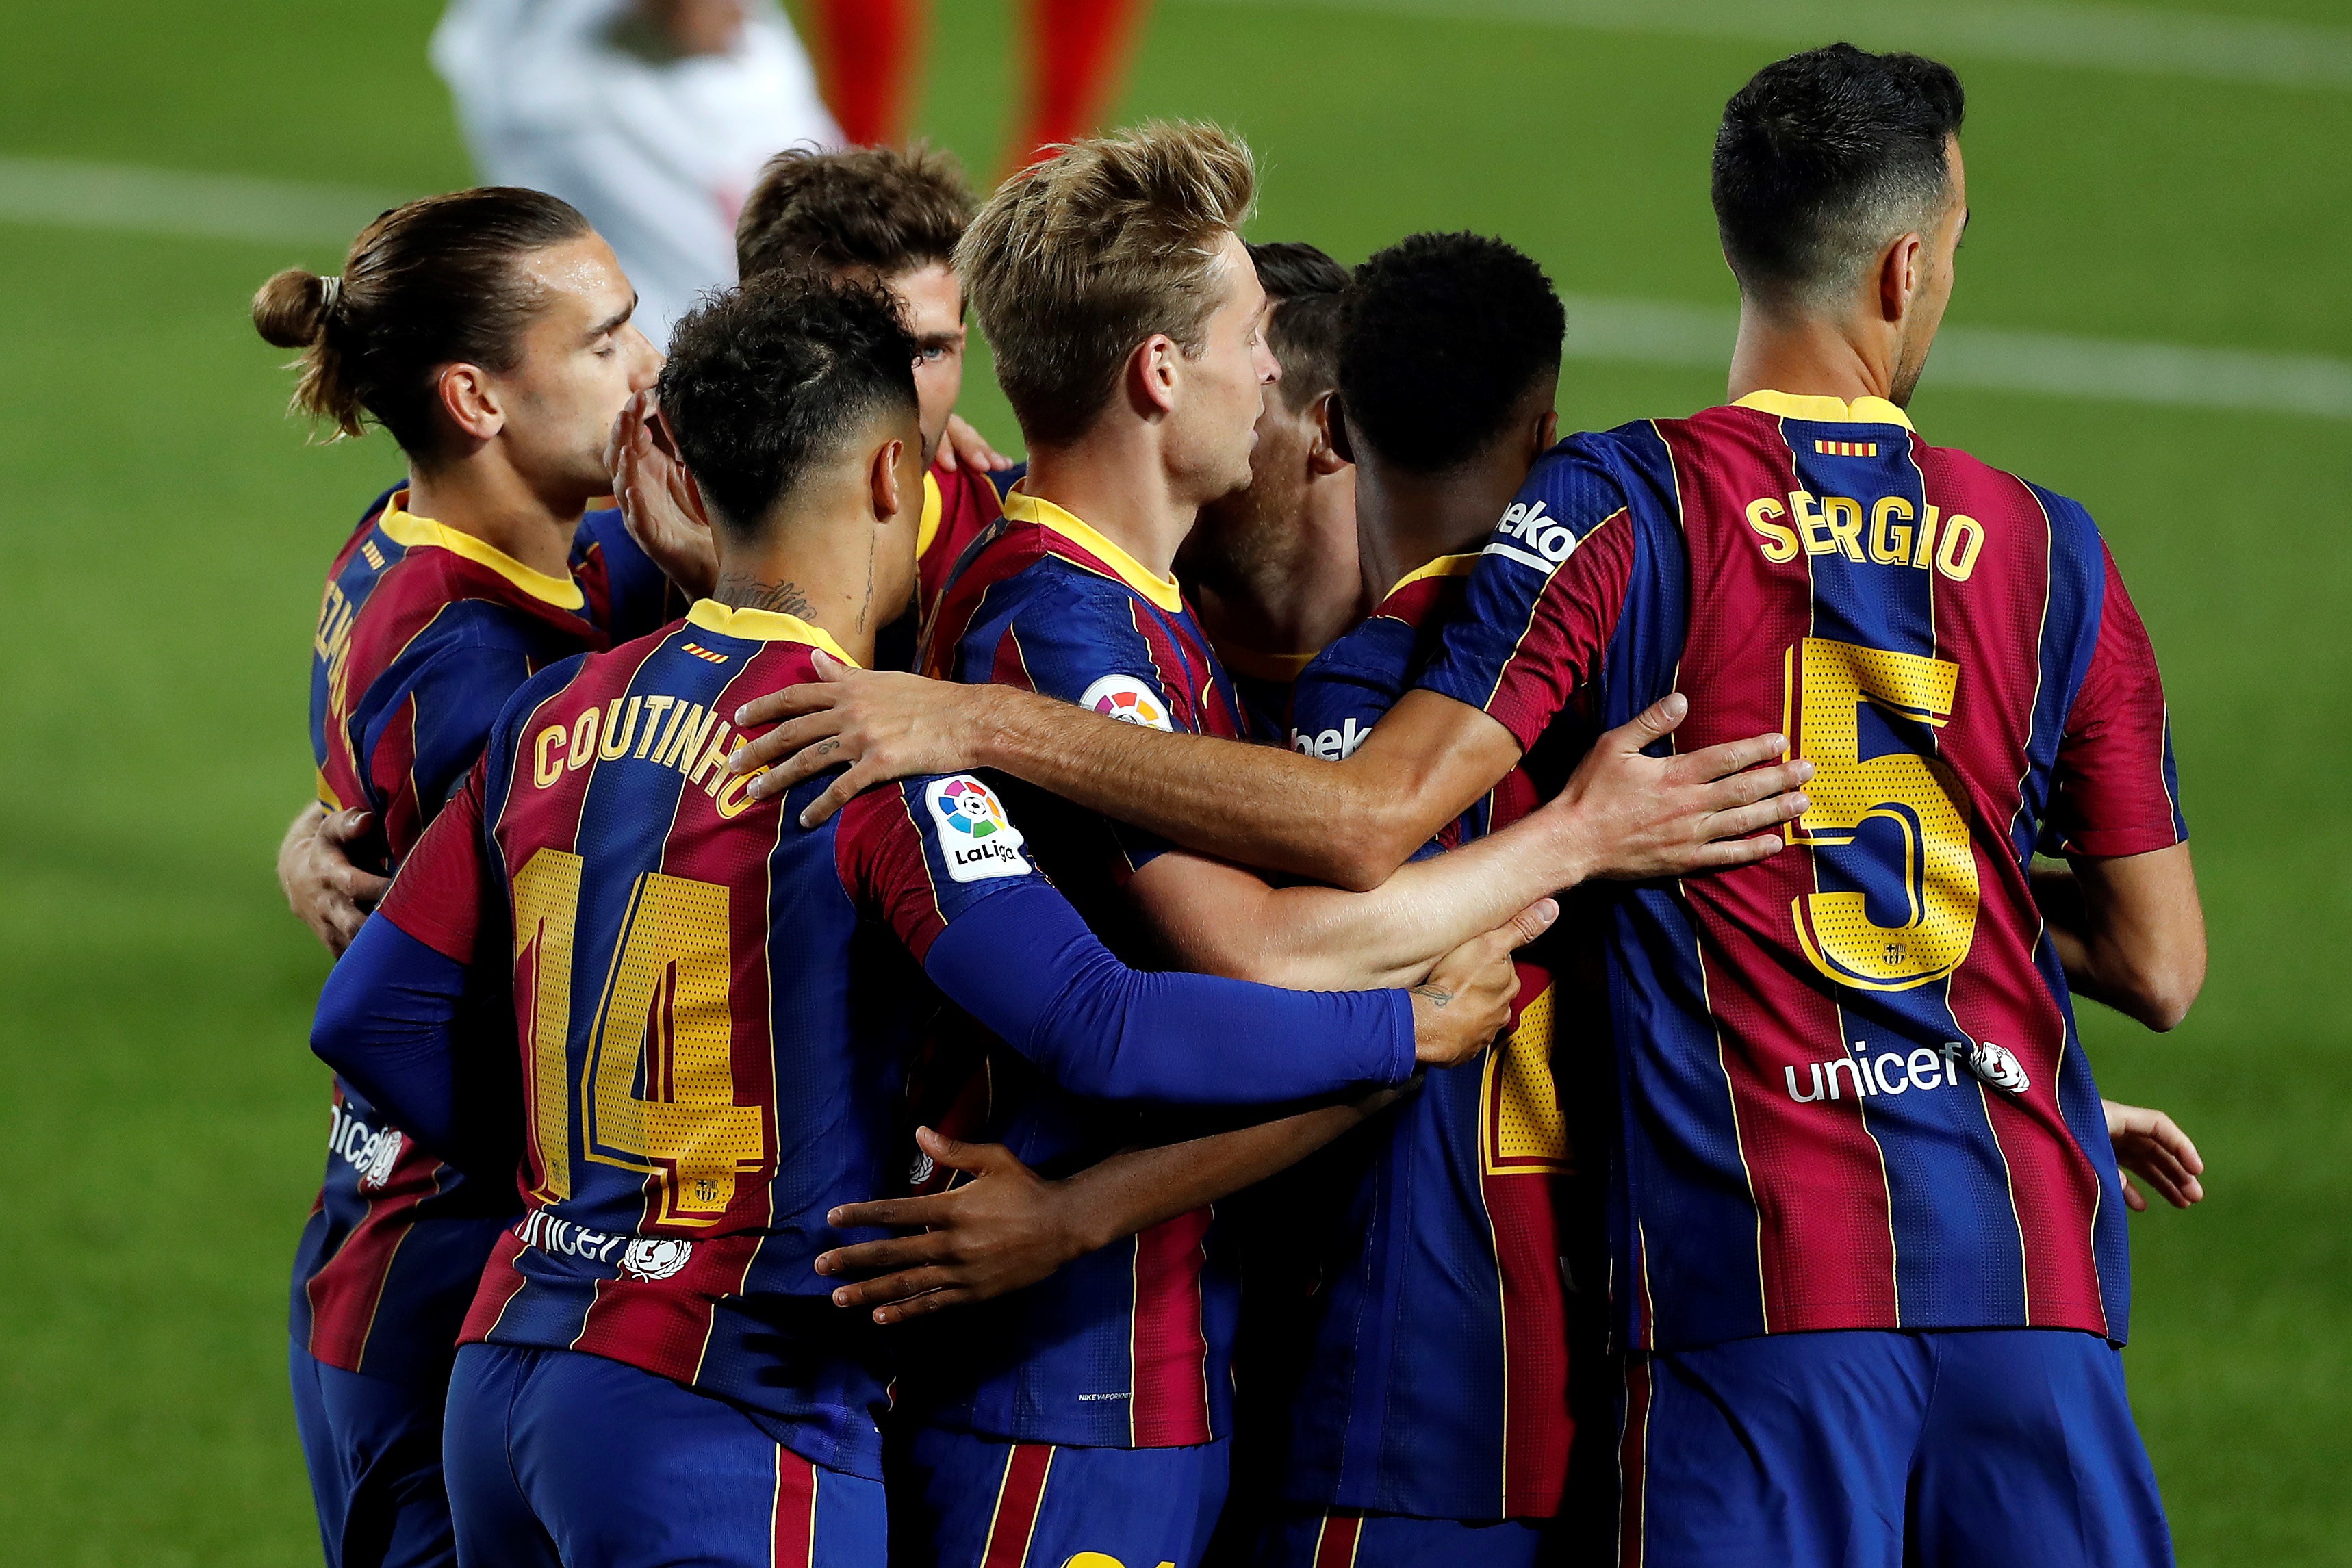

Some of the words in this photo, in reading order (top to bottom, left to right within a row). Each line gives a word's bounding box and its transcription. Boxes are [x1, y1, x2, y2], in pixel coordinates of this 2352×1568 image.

[1496, 500, 1576, 562] eko
[1746, 491, 1984, 582] SERGIO
[1290, 717, 1372, 762] bek
[1782, 637, 1980, 991] 5
[955, 839, 1017, 865] LaLiga
[513, 847, 765, 1227] 14
[1784, 1040, 1962, 1103] unicef
[1078, 1393, 1097, 1402] NIKE
